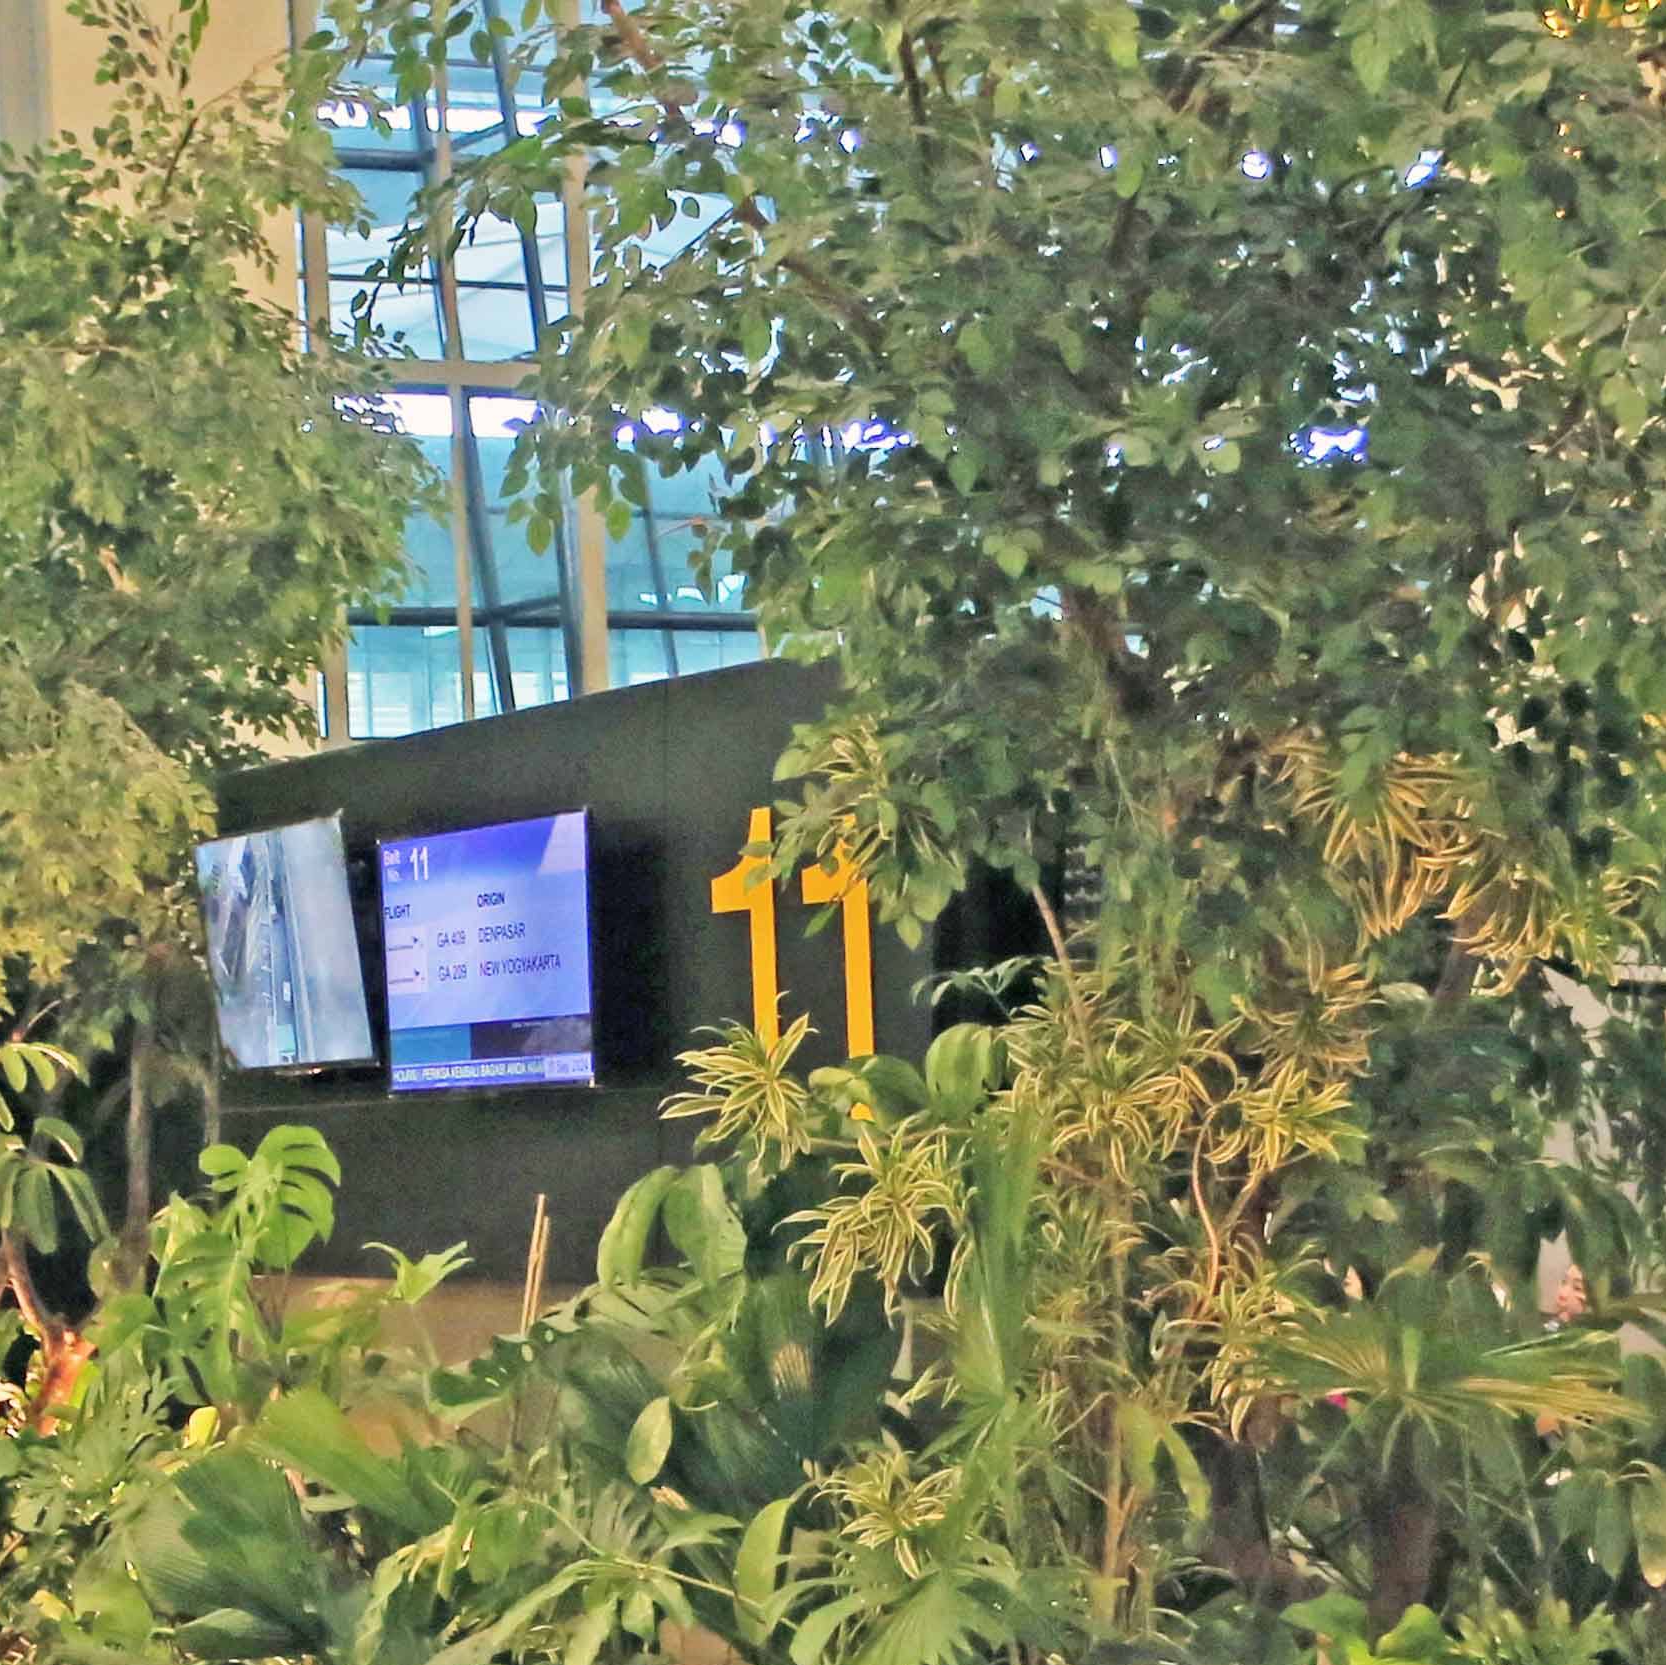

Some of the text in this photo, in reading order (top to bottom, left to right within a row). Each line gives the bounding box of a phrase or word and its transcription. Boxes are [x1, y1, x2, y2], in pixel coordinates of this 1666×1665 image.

[410, 846, 429, 880] 11
[384, 904, 411, 920] FLIGHT
[477, 892, 506, 908] ORIGIN
[437, 931, 450, 947] GA
[478, 922, 526, 943] DENPASAR
[438, 965, 451, 981] GA
[479, 960, 500, 976] NEW
[501, 953, 561, 975] YOGYAKARTA
[711, 807, 874, 1120] 11
